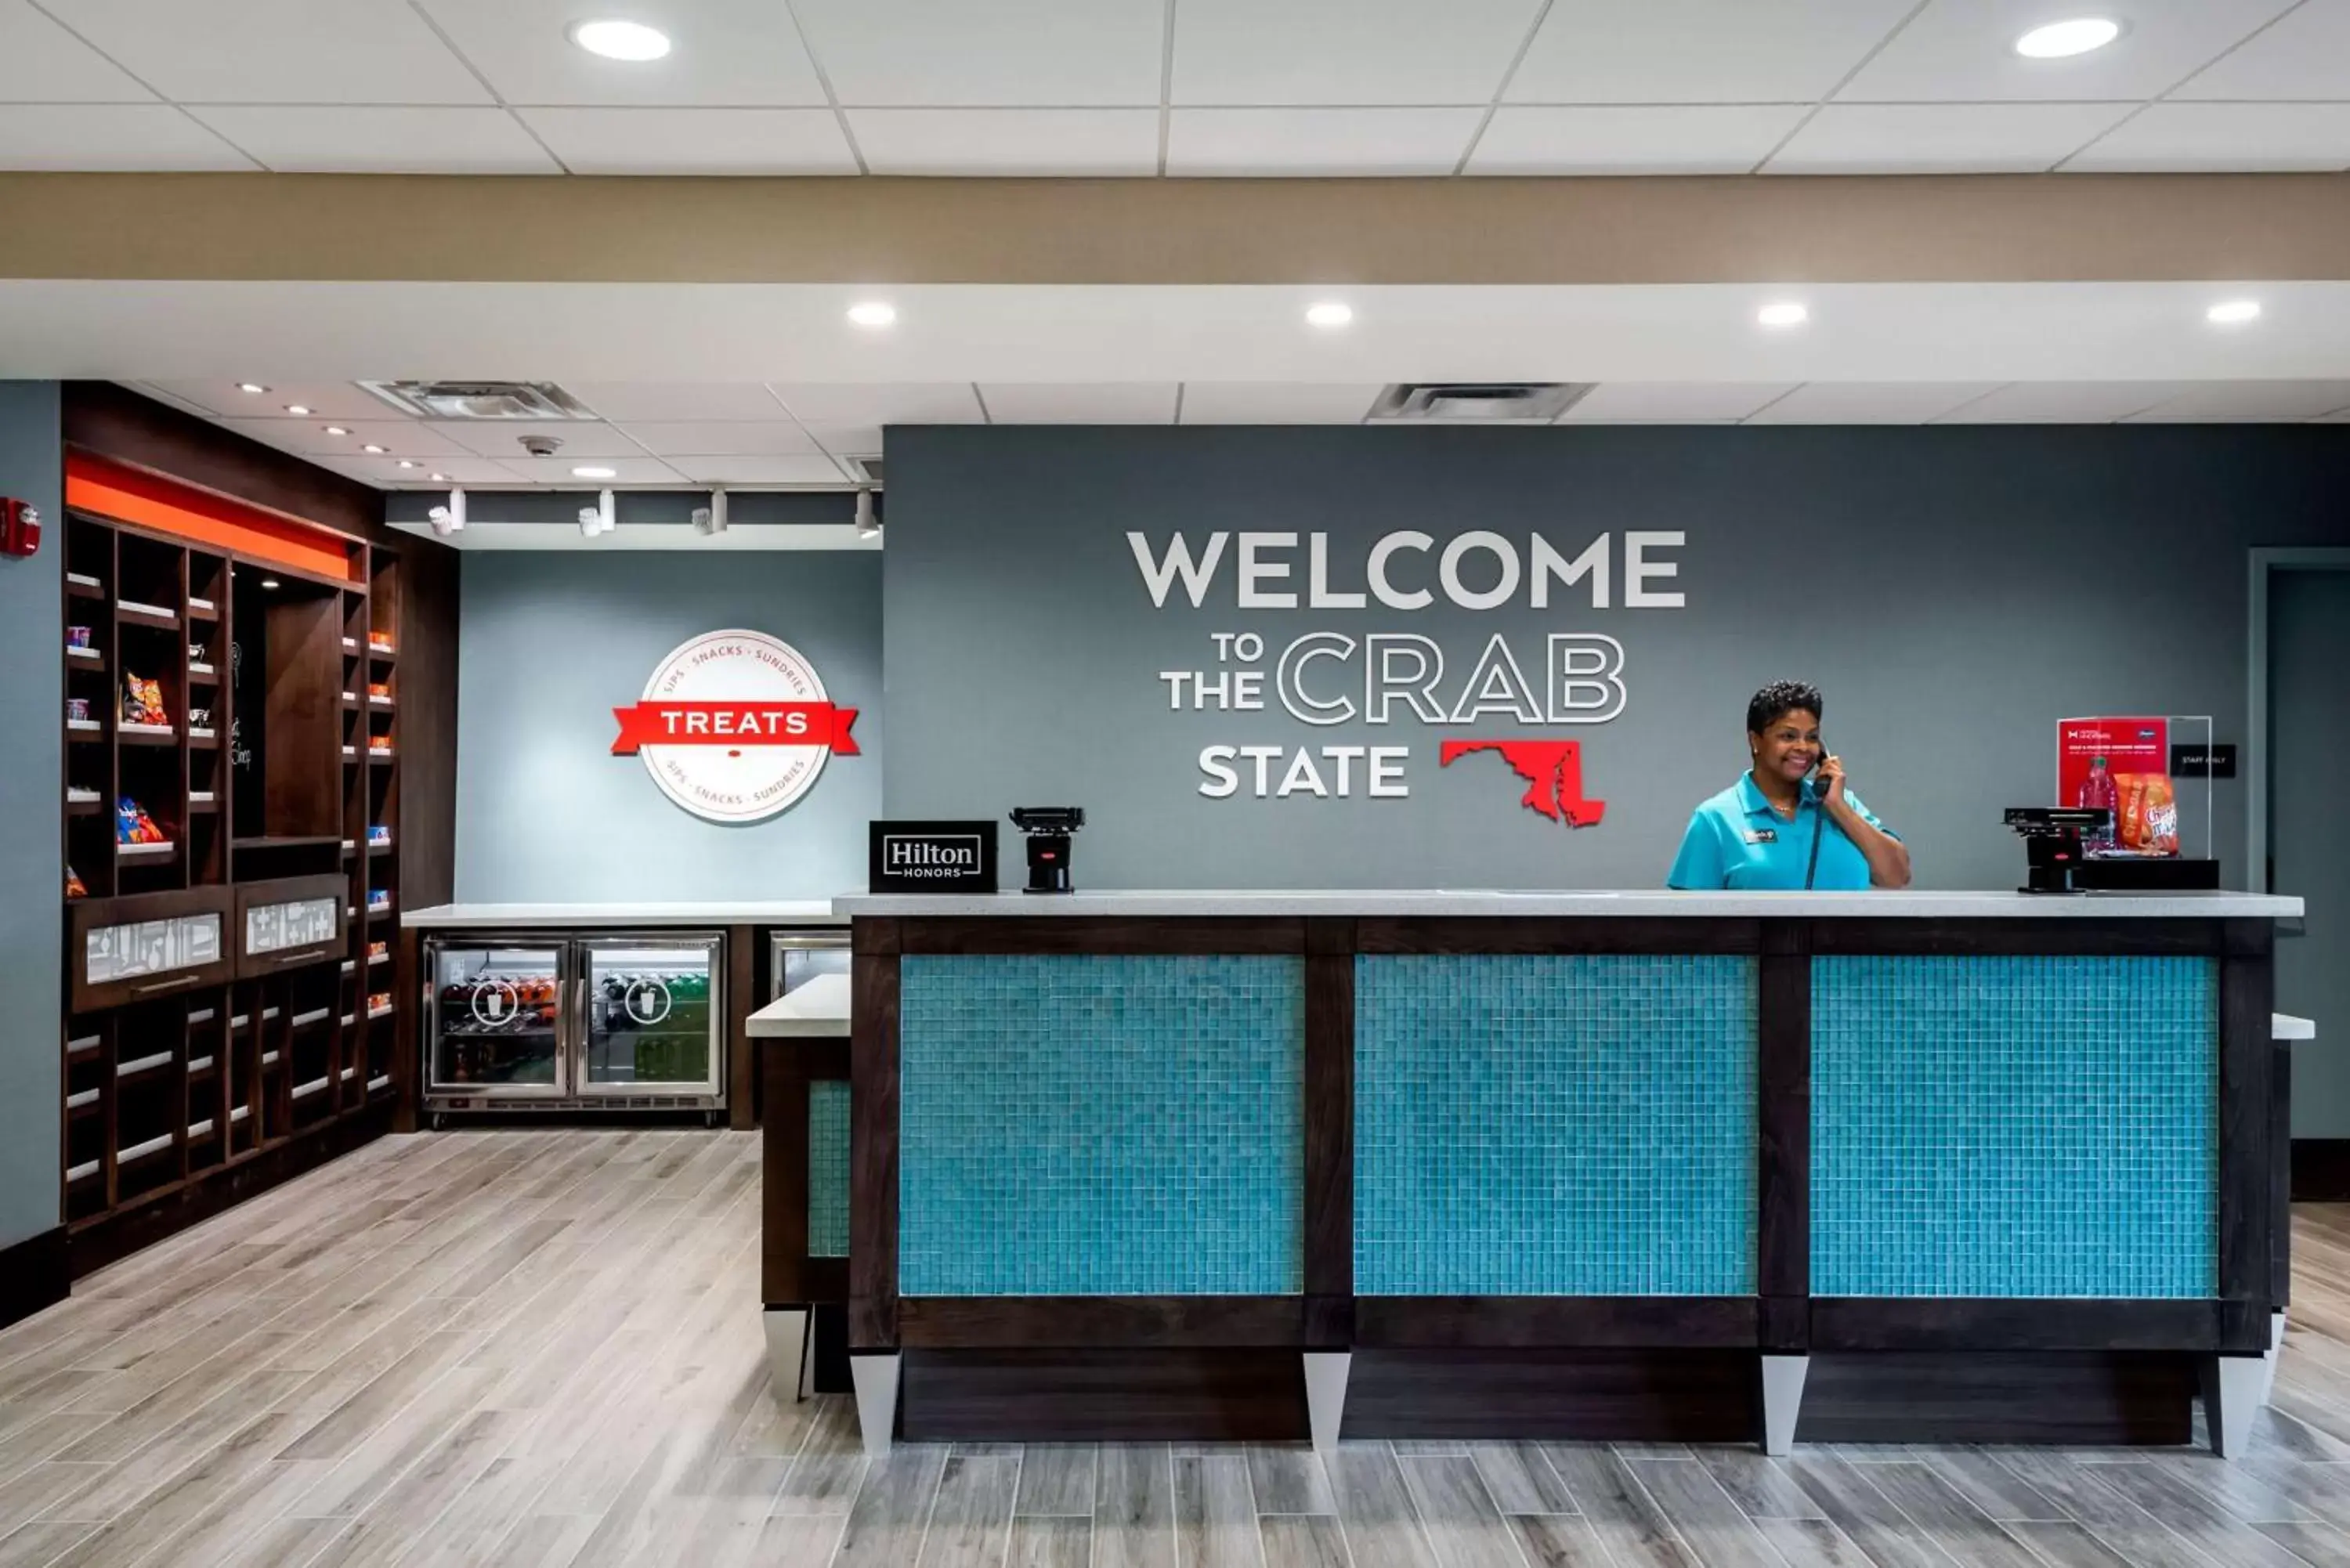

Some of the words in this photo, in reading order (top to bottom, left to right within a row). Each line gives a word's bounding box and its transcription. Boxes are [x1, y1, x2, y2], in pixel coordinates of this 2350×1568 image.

[1126, 529, 1686, 610] WELCOME
[1211, 632, 1264, 663] TO
[663, 668, 685, 695] SIPS
[691, 645, 743, 667] SNACKS
[754, 649, 807, 696] SUNDRIES
[1159, 670, 1264, 710] THE
[1276, 631, 1627, 726] CRAB
[660, 710, 808, 734] TREATS
[1198, 744, 1409, 797] STATE
[2182, 756, 2204, 765] STAFF
[667, 761, 686, 784] SIPS
[696, 785, 743, 805] SNACKS
[754, 760, 805, 802] SUNDRIES
[891, 842, 973, 865] Hilton
[903, 868, 961, 878] HONORS
